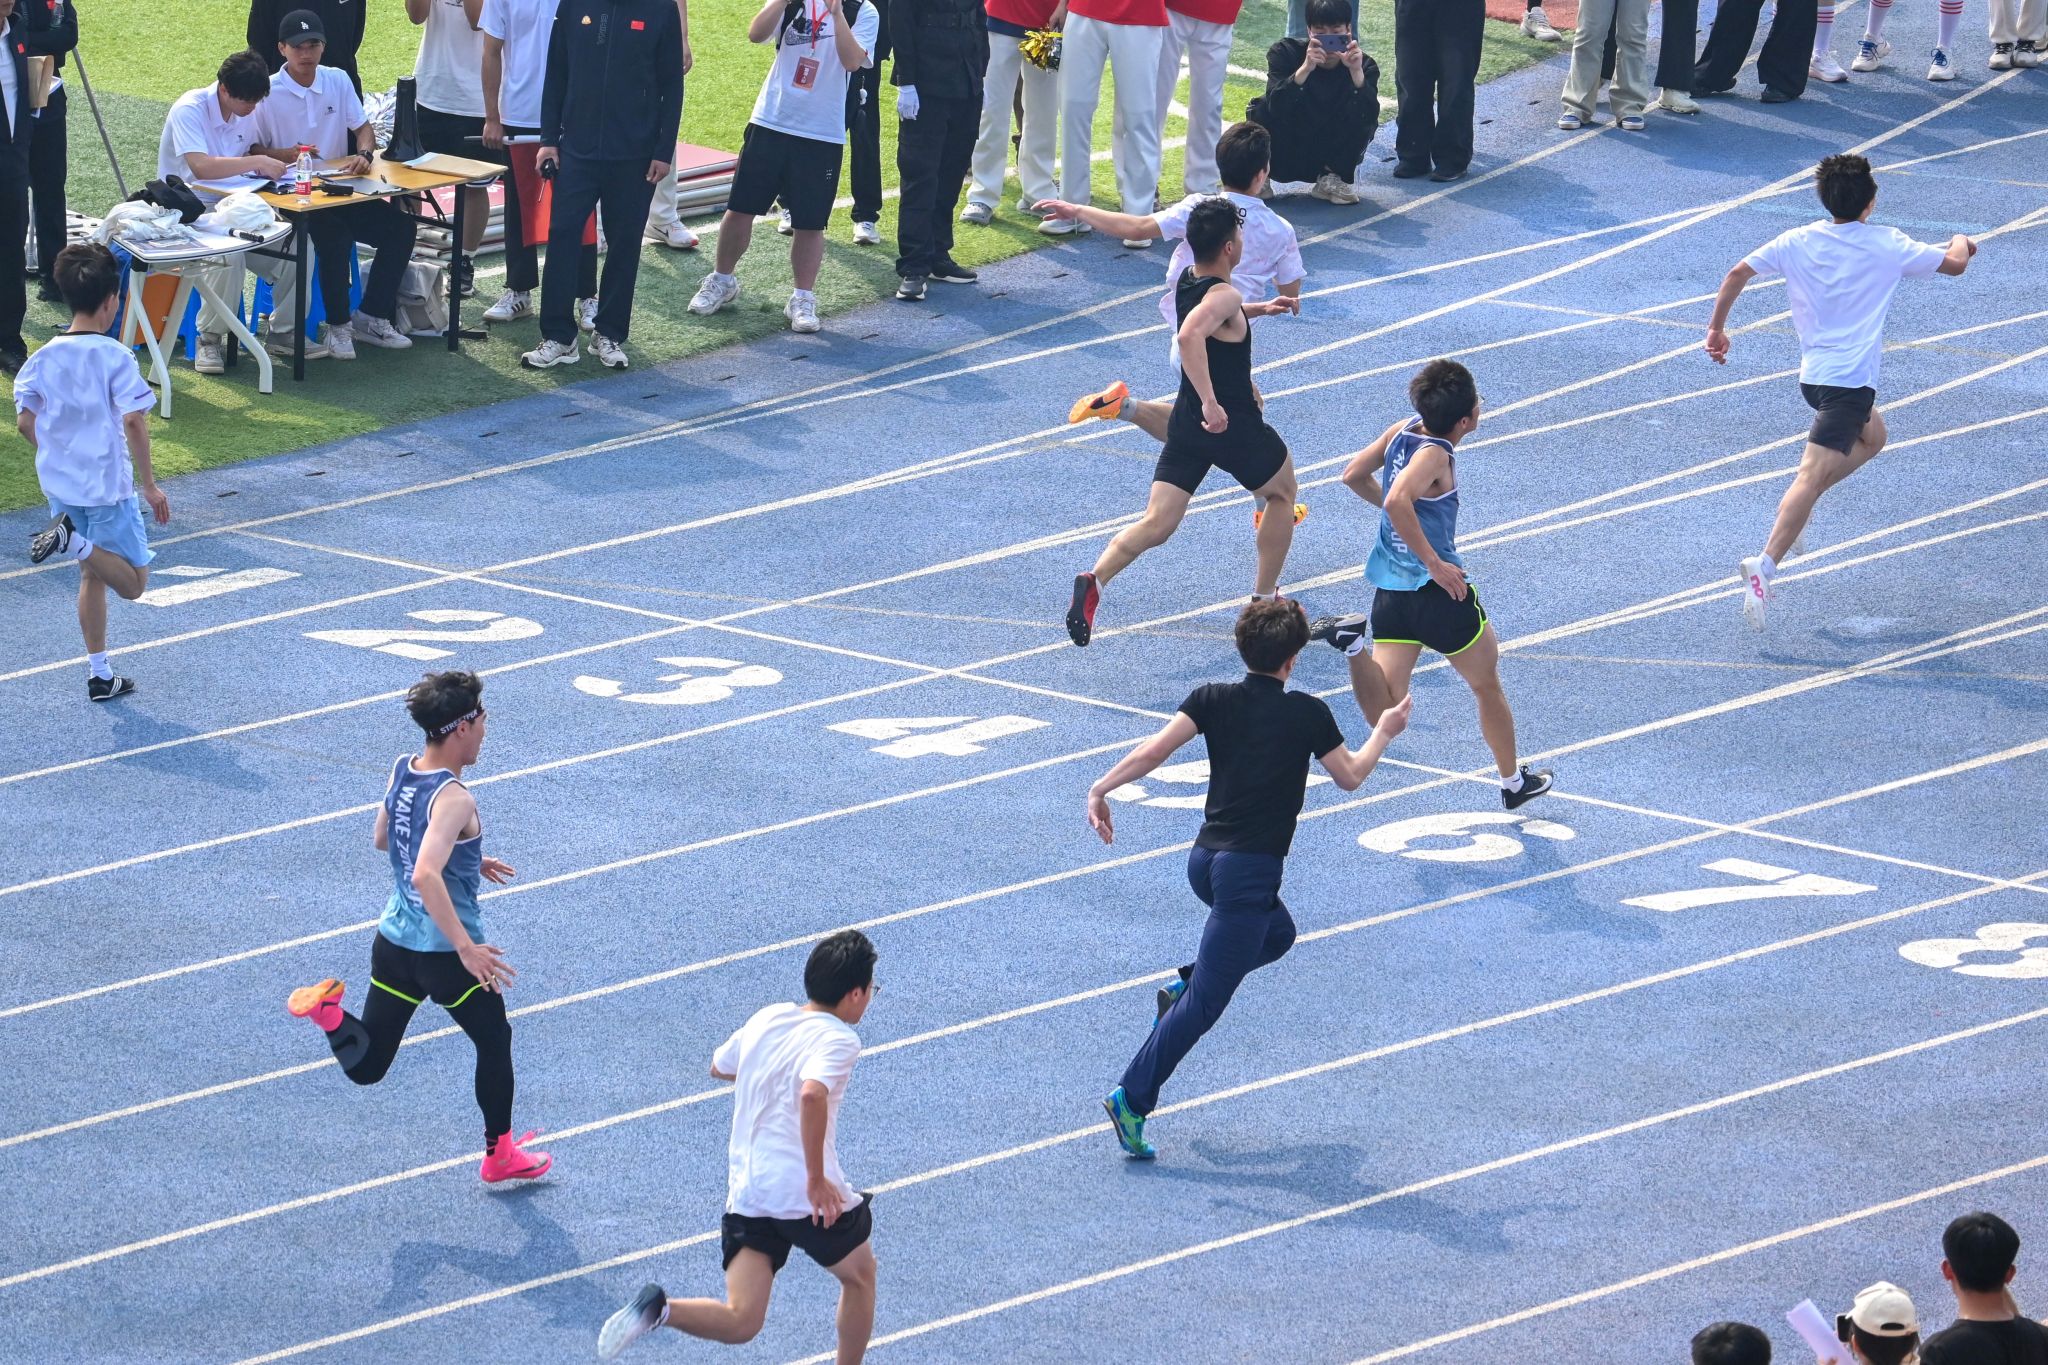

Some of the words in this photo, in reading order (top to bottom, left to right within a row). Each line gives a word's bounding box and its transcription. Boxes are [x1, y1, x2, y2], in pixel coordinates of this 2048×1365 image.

[302, 609, 544, 661] 2
[573, 656, 784, 705] 3
[825, 715, 1053, 759] 4
[395, 786, 417, 838] WAKE
[1357, 811, 1576, 862] 6
[1620, 857, 1878, 912] 7
[1899, 922, 2048, 979] 8
